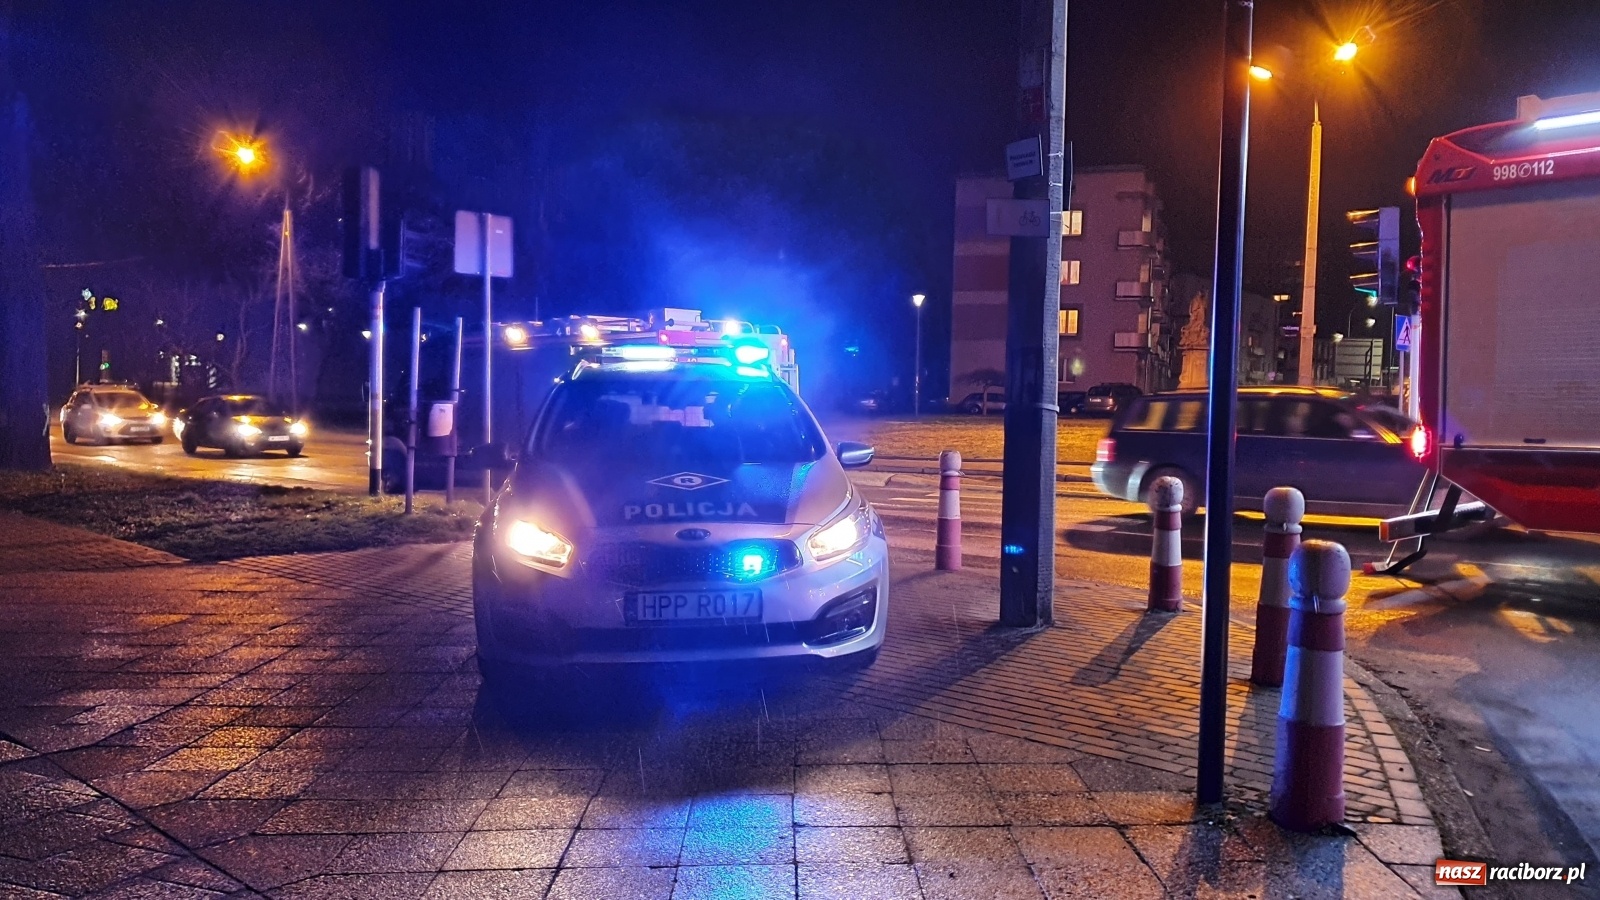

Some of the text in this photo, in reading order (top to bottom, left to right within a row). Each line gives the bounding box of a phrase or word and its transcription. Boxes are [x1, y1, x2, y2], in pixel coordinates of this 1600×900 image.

[1493, 160, 1554, 181] 998 112
[624, 502, 758, 520] POLICJA
[642, 592, 755, 618] HPP R017
